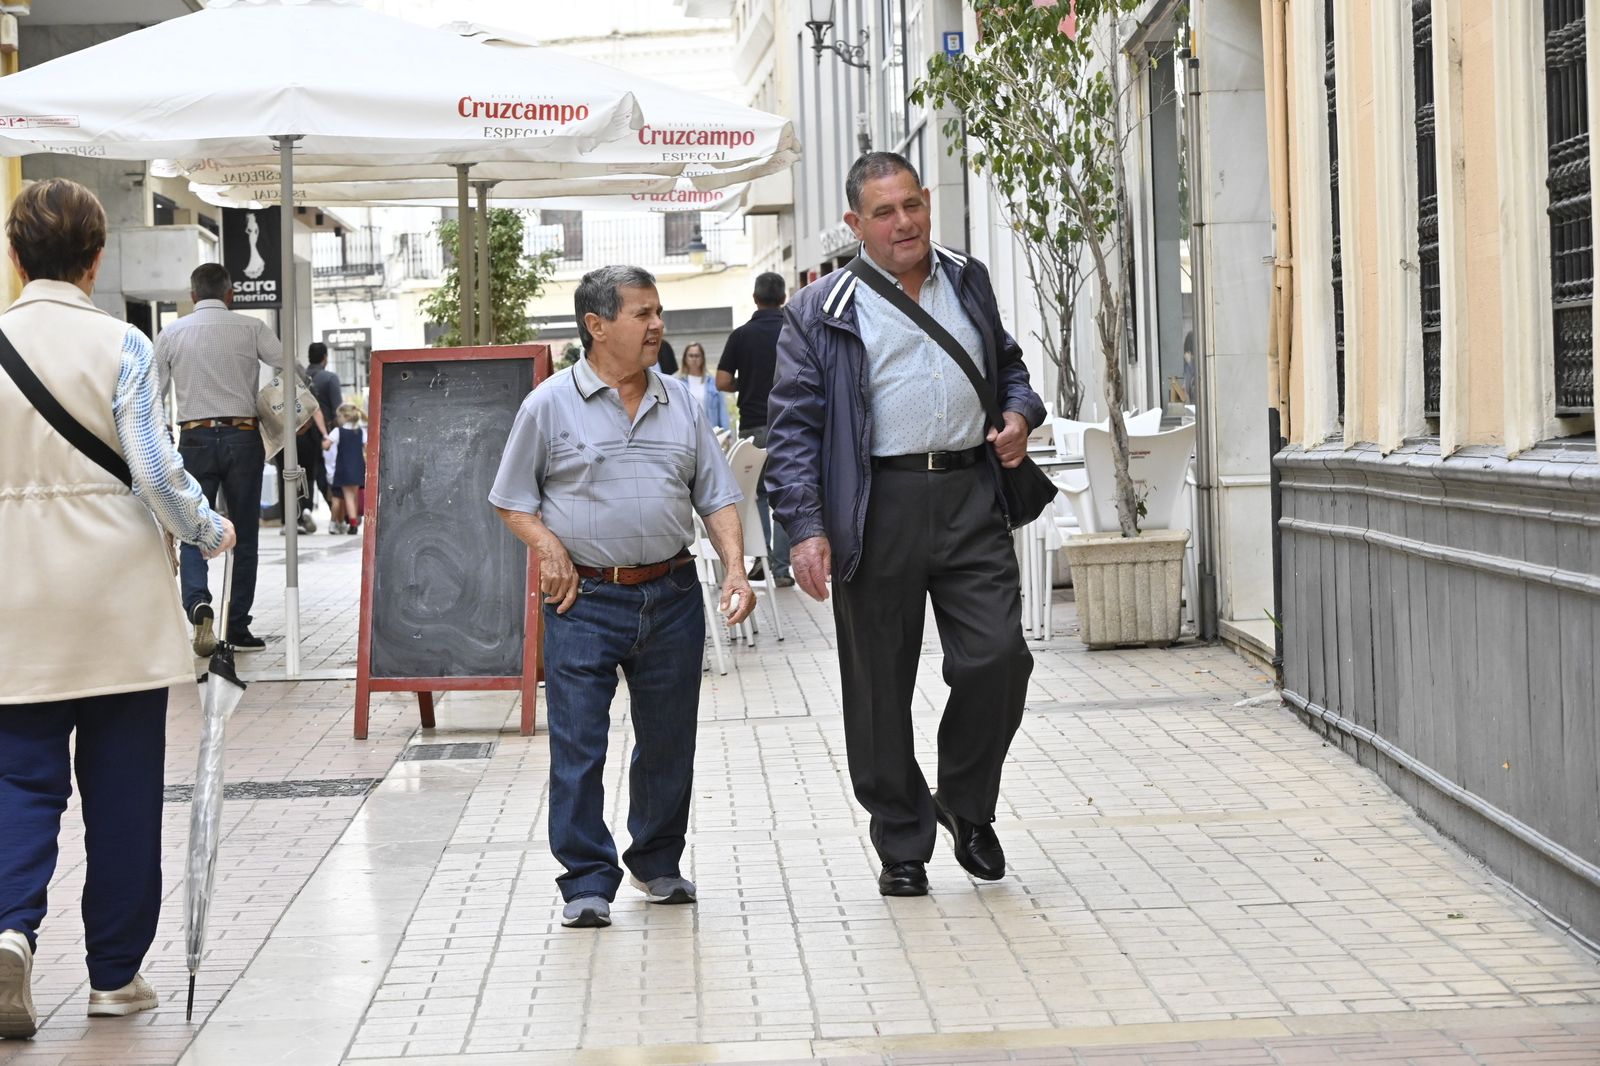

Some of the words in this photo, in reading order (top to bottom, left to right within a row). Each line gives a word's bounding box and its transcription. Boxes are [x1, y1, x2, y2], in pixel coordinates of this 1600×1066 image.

[458, 96, 589, 125] Cruzcampo
[638, 124, 755, 149] Cruzcampo
[233, 280, 276, 293] sara
[233, 292, 277, 302] merino
